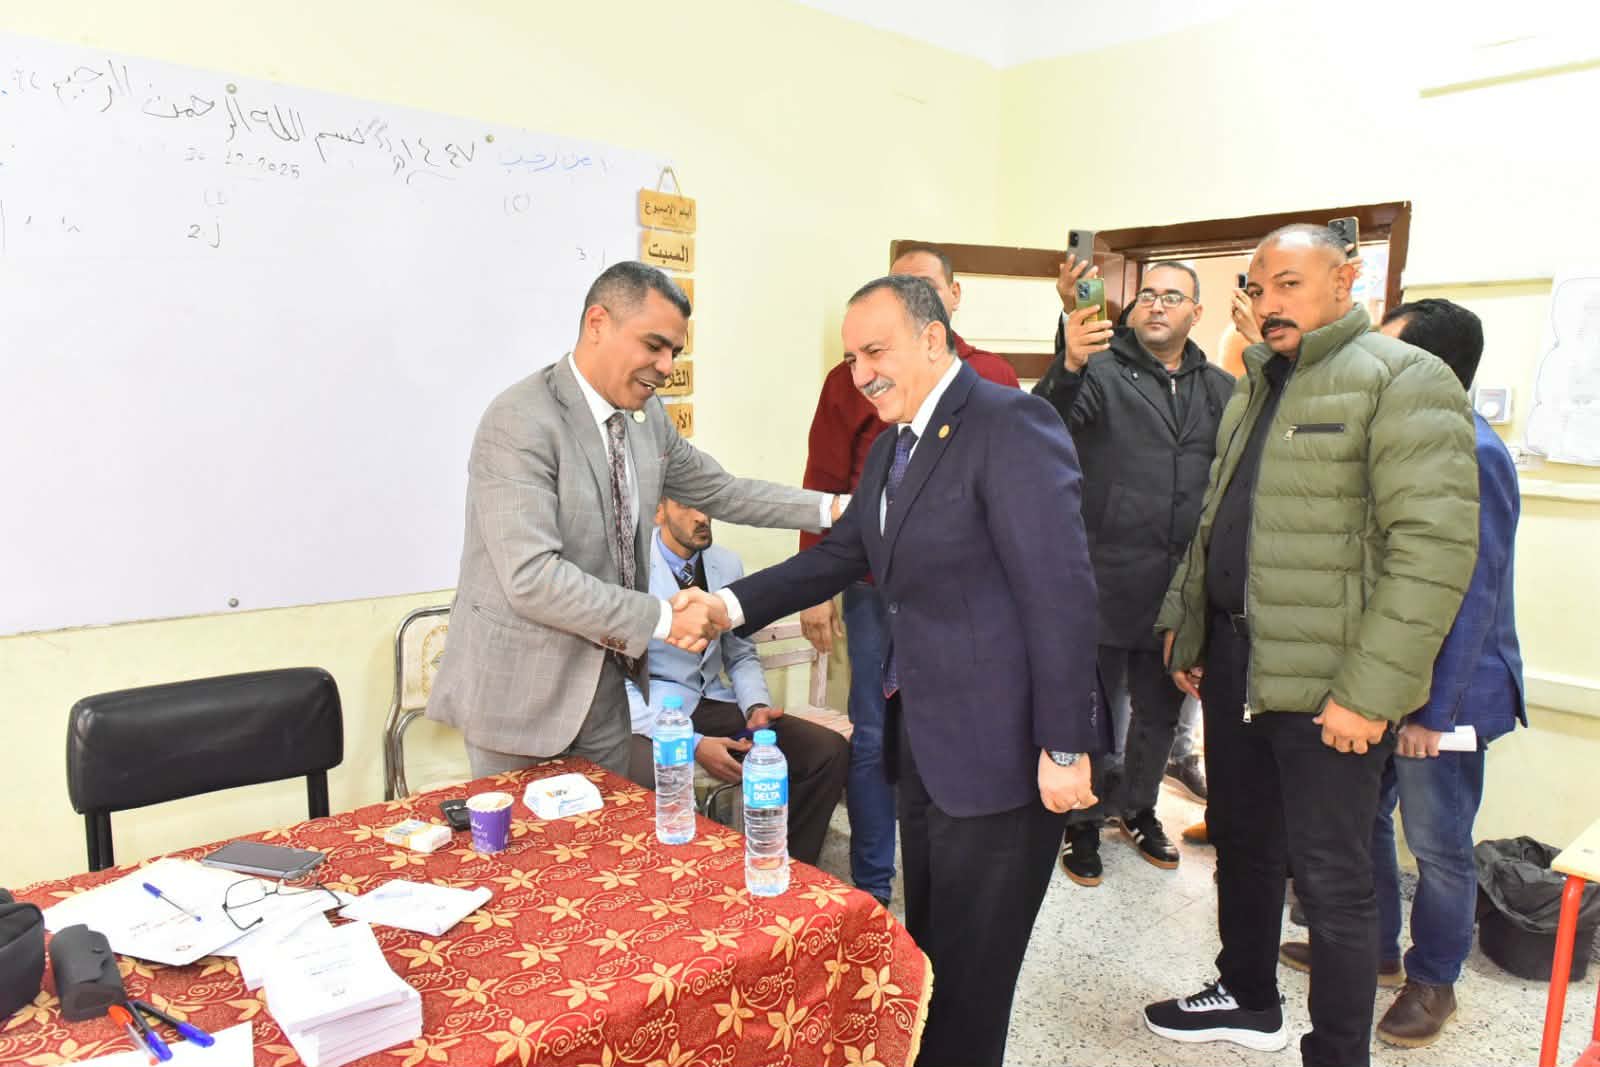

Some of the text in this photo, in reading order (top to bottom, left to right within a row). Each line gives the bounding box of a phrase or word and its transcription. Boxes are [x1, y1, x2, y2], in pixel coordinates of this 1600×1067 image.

[648, 243, 689, 264] السبت
[753, 782, 781, 792] AQUA
[753, 791, 781, 801] DELTA
